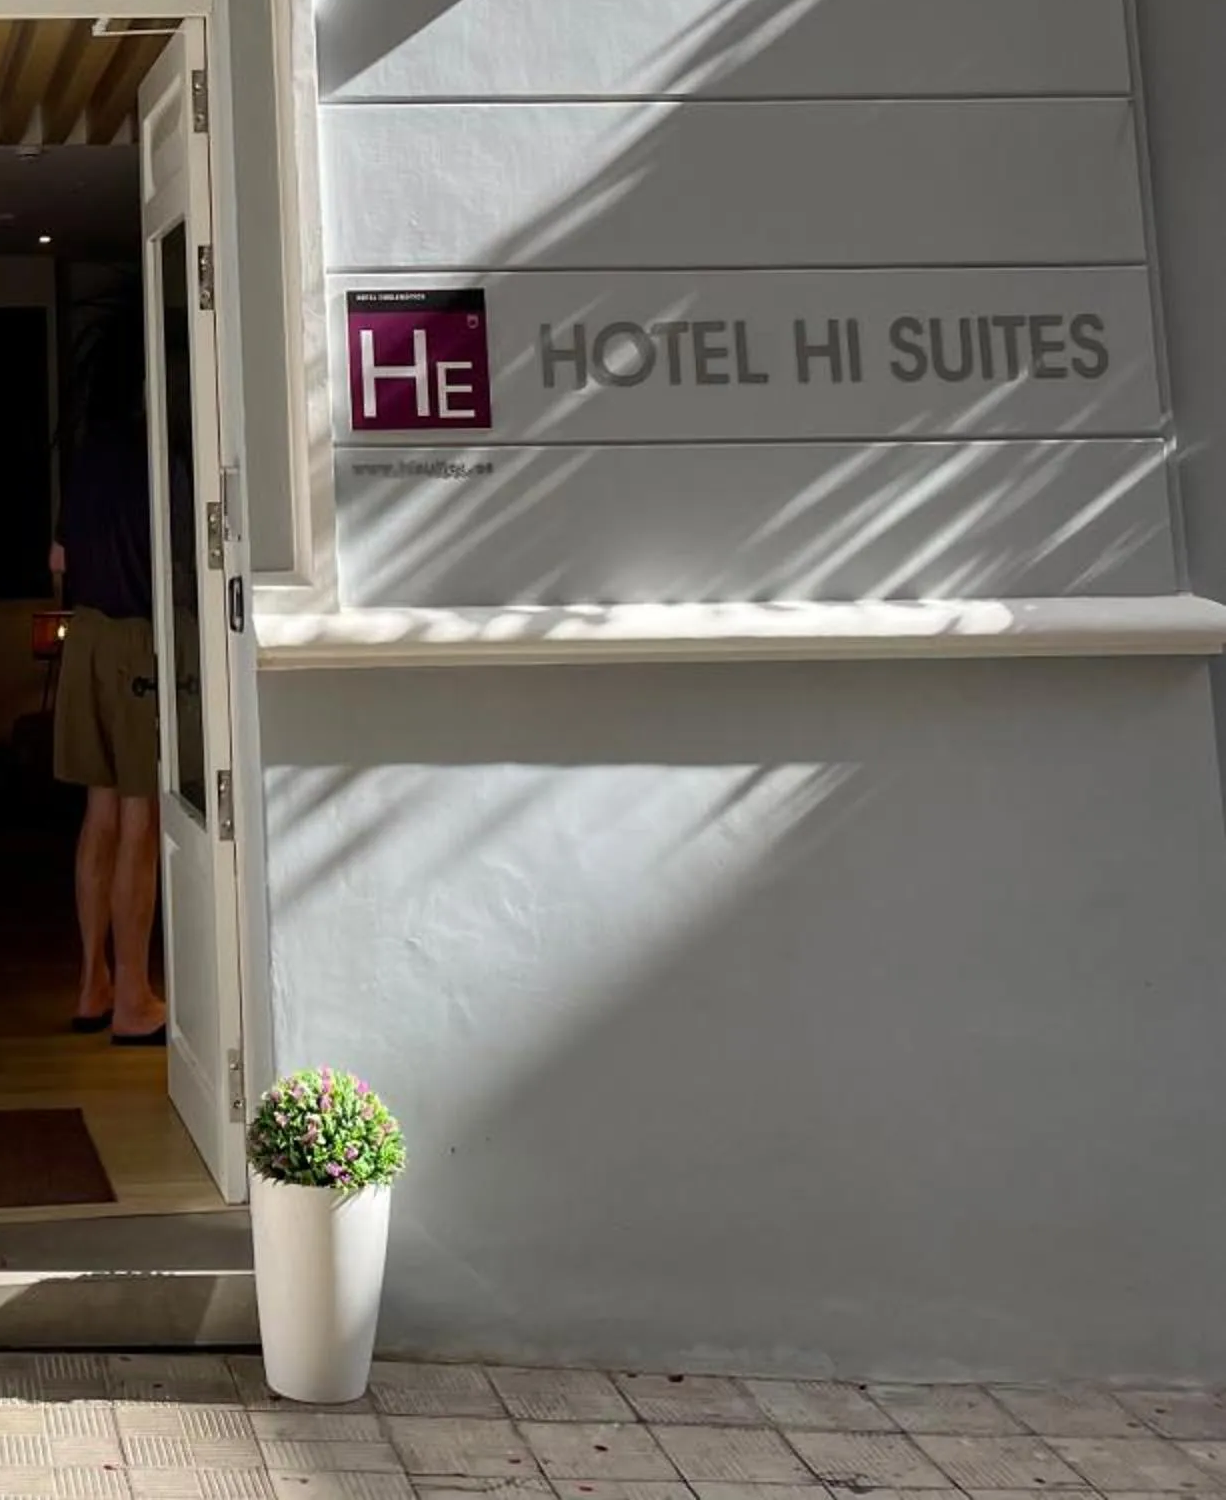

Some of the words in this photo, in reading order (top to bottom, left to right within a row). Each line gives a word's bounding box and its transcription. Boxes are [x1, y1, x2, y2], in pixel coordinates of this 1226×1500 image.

[540, 320, 770, 388] HOTEL
[794, 318, 863, 384] HI
[889, 313, 1109, 383] SUITES
